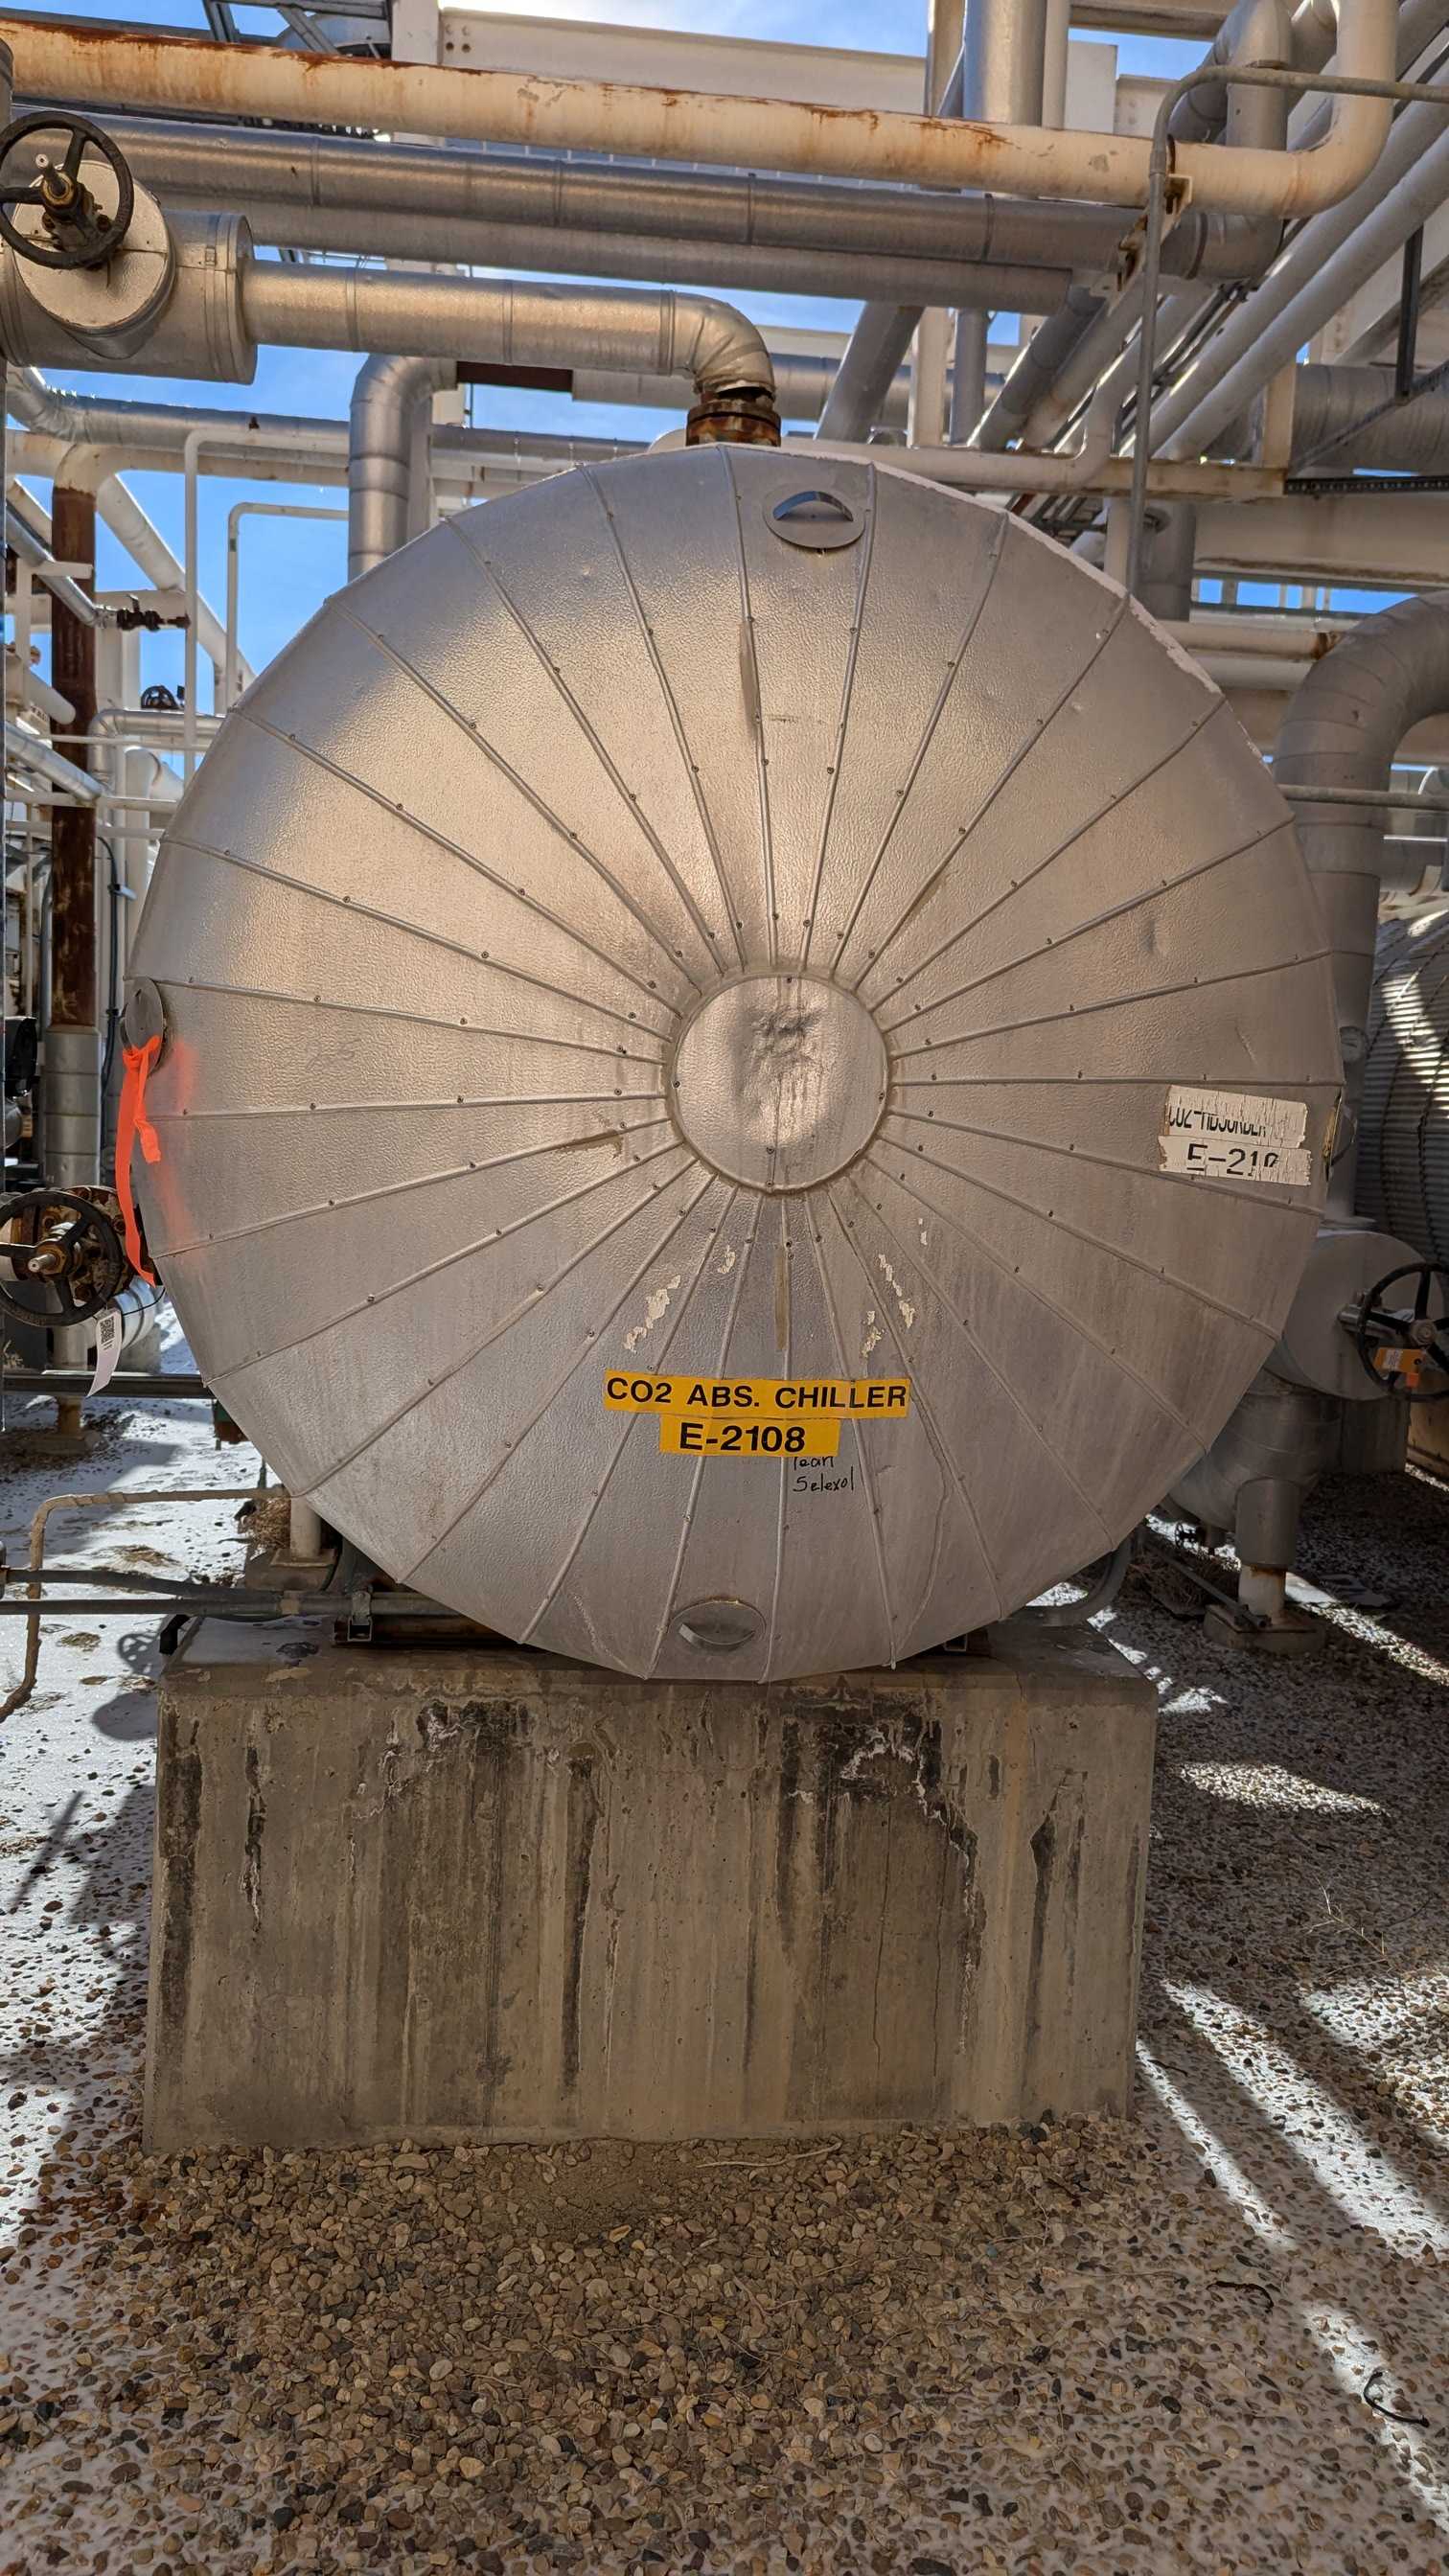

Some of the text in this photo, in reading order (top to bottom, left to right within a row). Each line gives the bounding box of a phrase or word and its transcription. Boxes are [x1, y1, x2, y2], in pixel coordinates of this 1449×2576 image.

[606, 1376, 907, 1410] CO2 ABS. CHILLER
[678, 1421, 806, 1453] E-2108
[793, 1465, 854, 1492] Selexol
